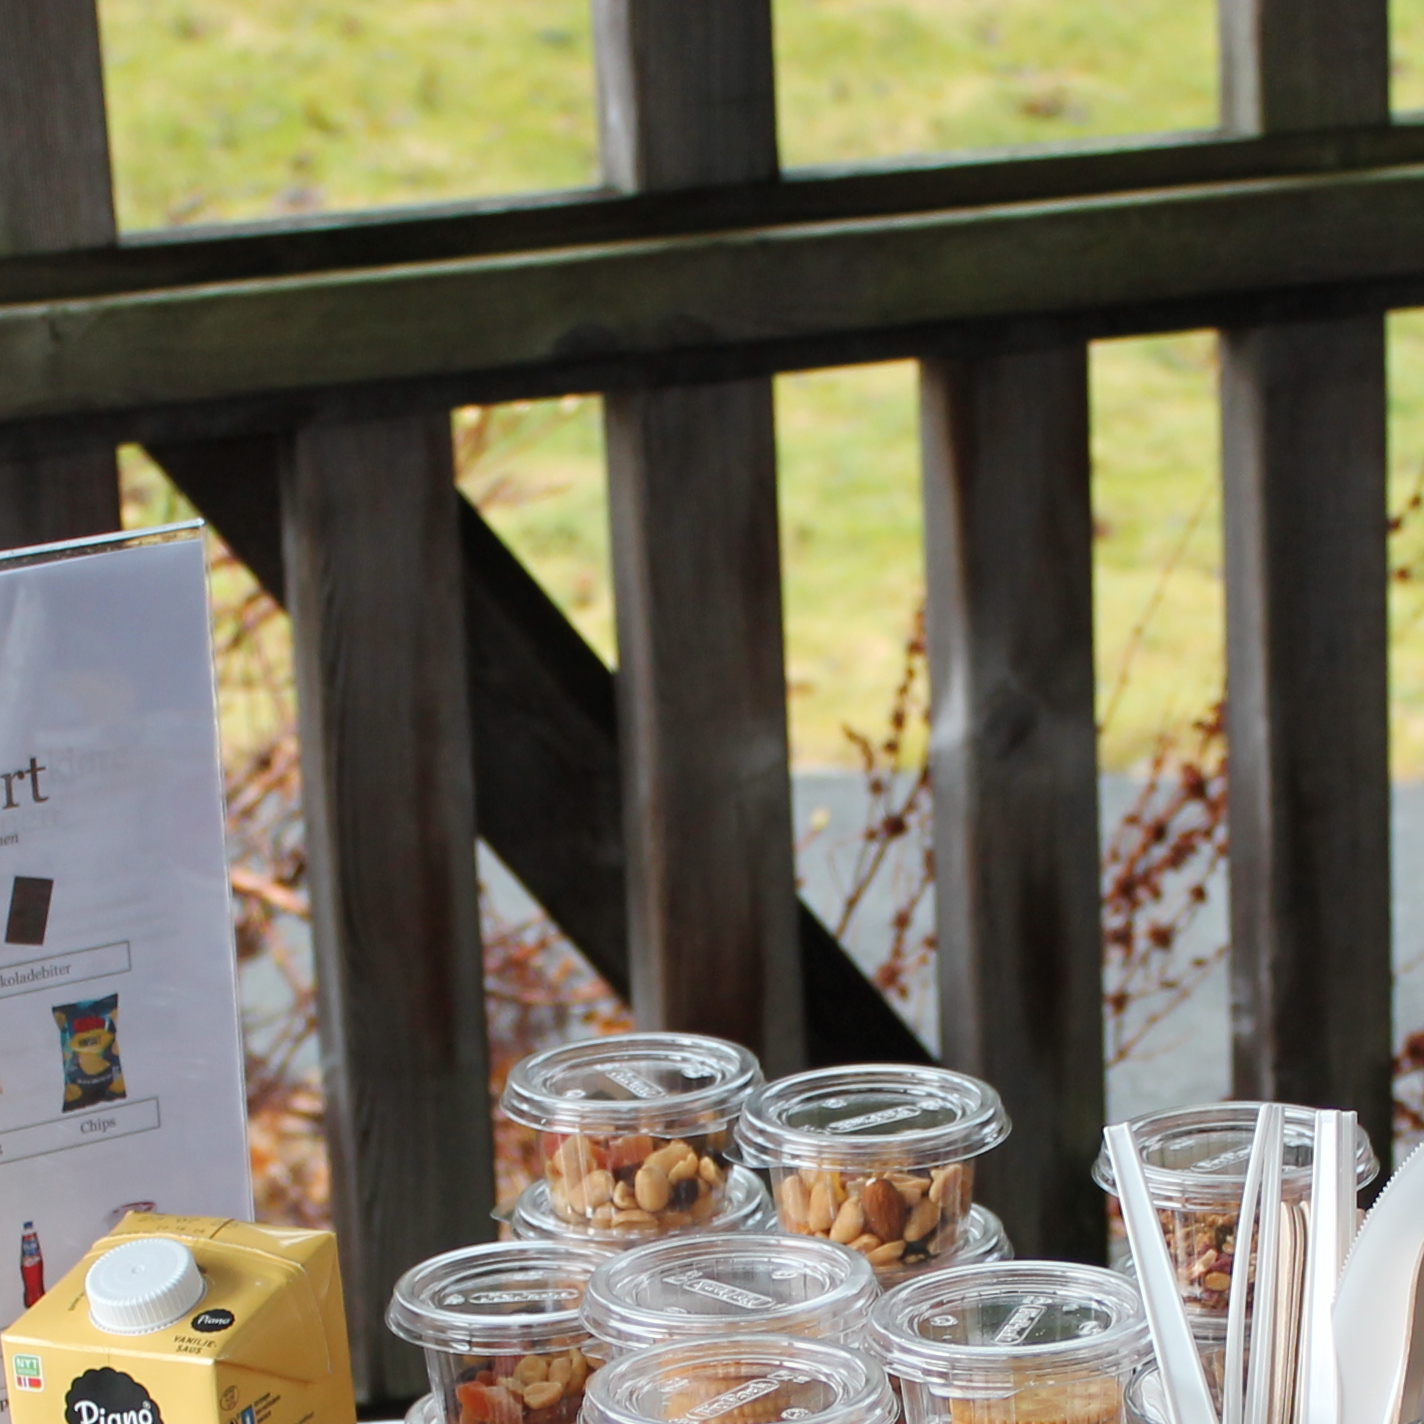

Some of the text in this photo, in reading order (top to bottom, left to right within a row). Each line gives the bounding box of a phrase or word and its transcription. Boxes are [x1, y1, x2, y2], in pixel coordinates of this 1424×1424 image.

[80, 1115, 117, 1136] Chips
[197, 1315, 231, 1327] Piano
[16, 1357, 37, 1370] NYT
